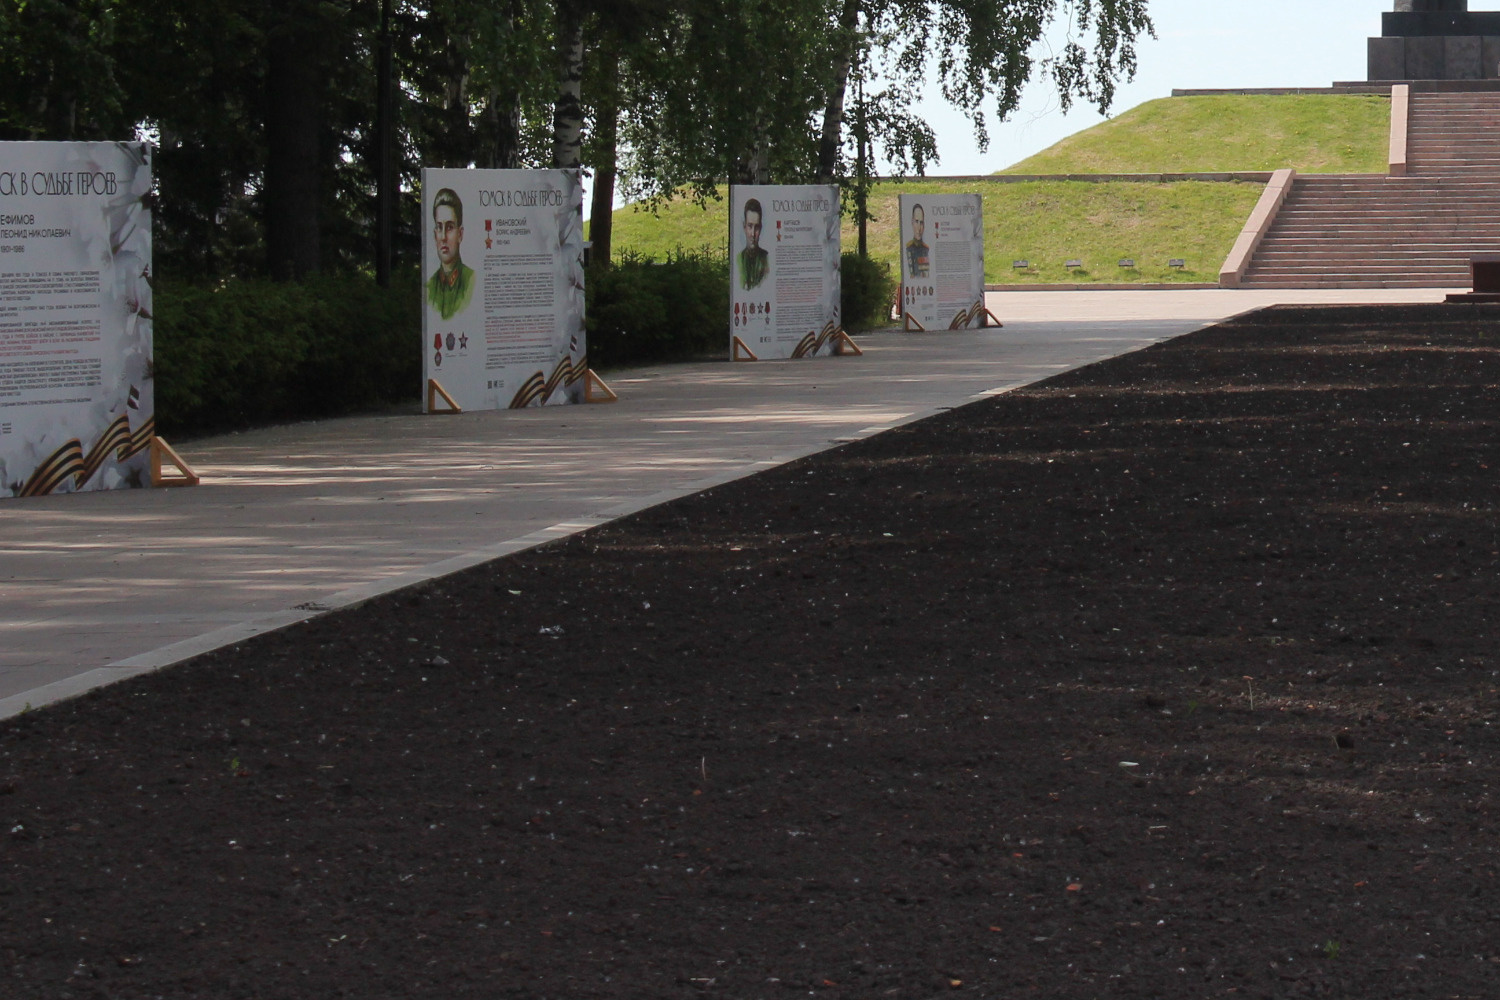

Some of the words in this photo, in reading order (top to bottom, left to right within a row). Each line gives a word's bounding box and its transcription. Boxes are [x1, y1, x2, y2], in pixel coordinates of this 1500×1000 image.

[21, 172, 28, 195] В
[32, 172, 73, 195] СУДЬБЕ
[77, 172, 117, 195] ГЕРОЕВ
[479, 190, 506, 207] ТОМСК
[508, 190, 512, 206] В
[0, 214, 35, 225] ЕФИМОВ
[29, 228, 71, 238] НИКОЛАЕВИЧ
